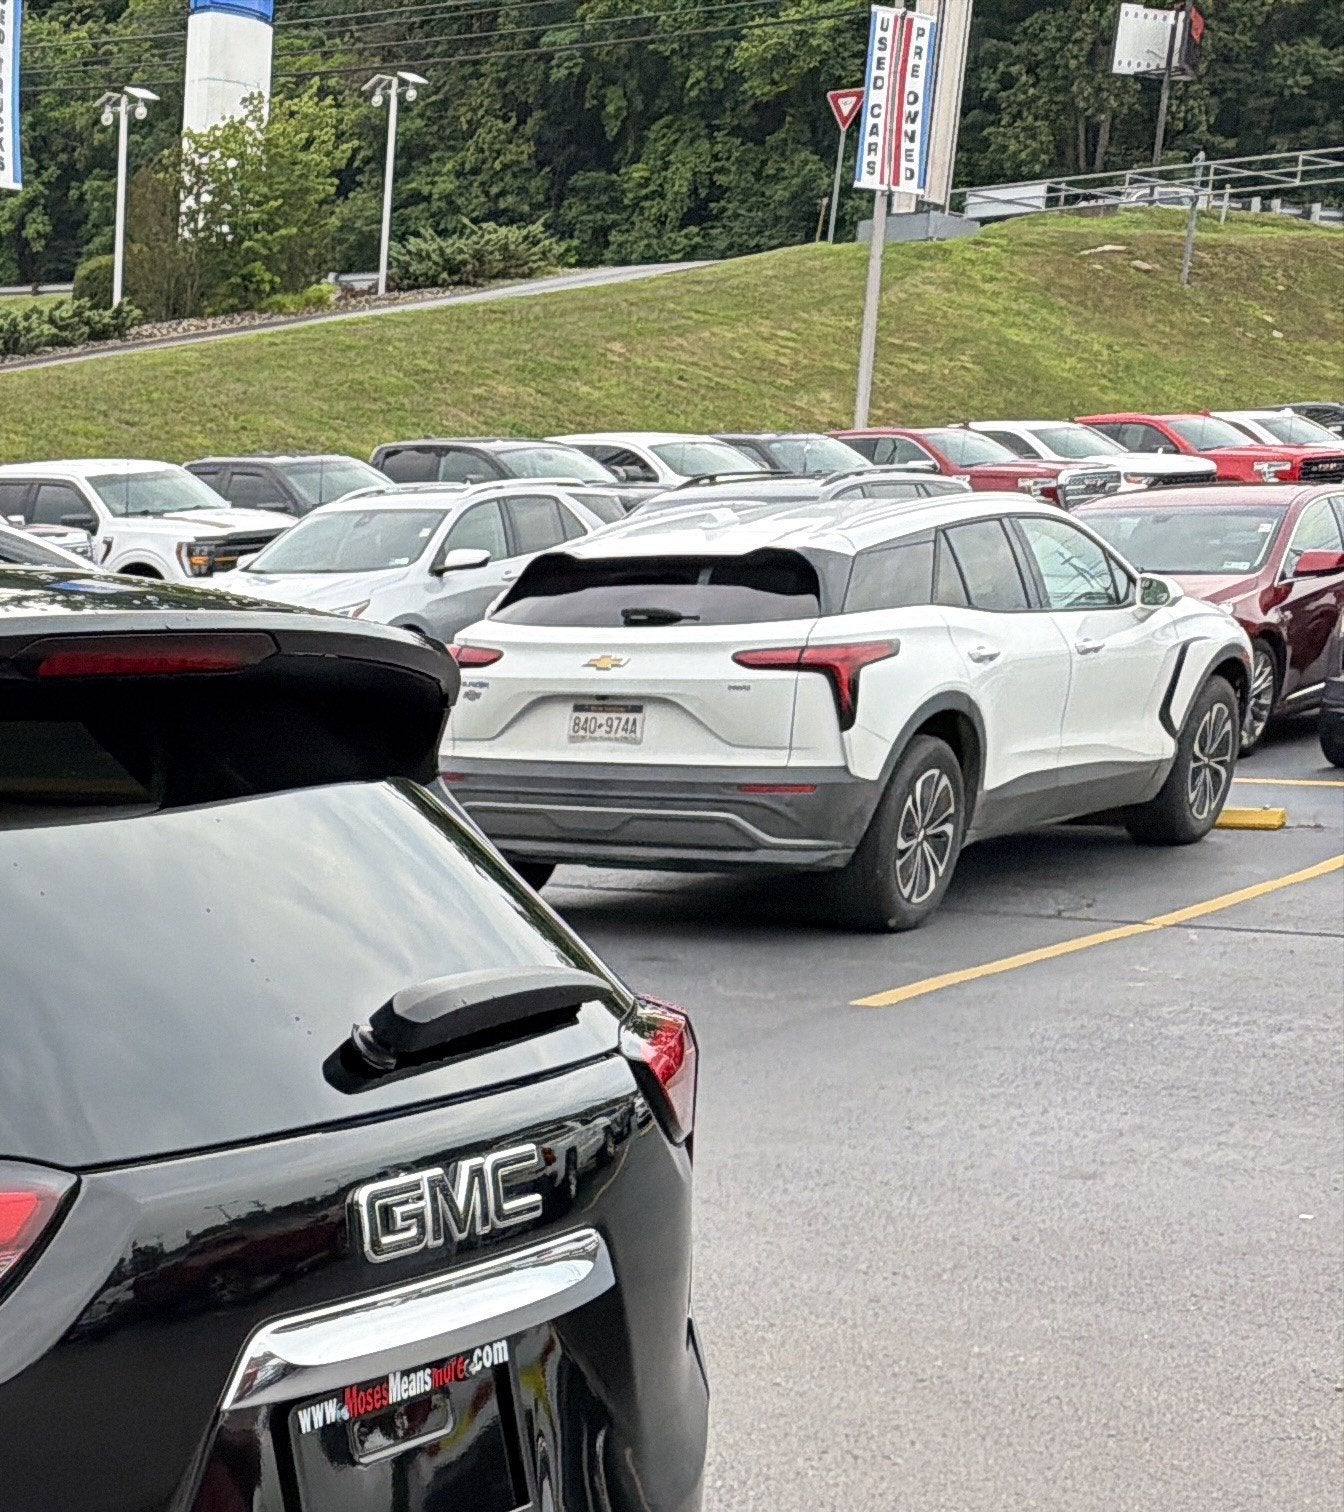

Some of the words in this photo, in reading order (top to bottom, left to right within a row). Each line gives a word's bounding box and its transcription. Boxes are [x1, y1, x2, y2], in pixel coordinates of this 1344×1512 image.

[872, 16, 890, 91] USED
[910, 26, 926, 79] PRE
[865, 103, 883, 176] CARS
[903, 90, 920, 181] OWNED
[357, 1142, 544, 1264] GMC
